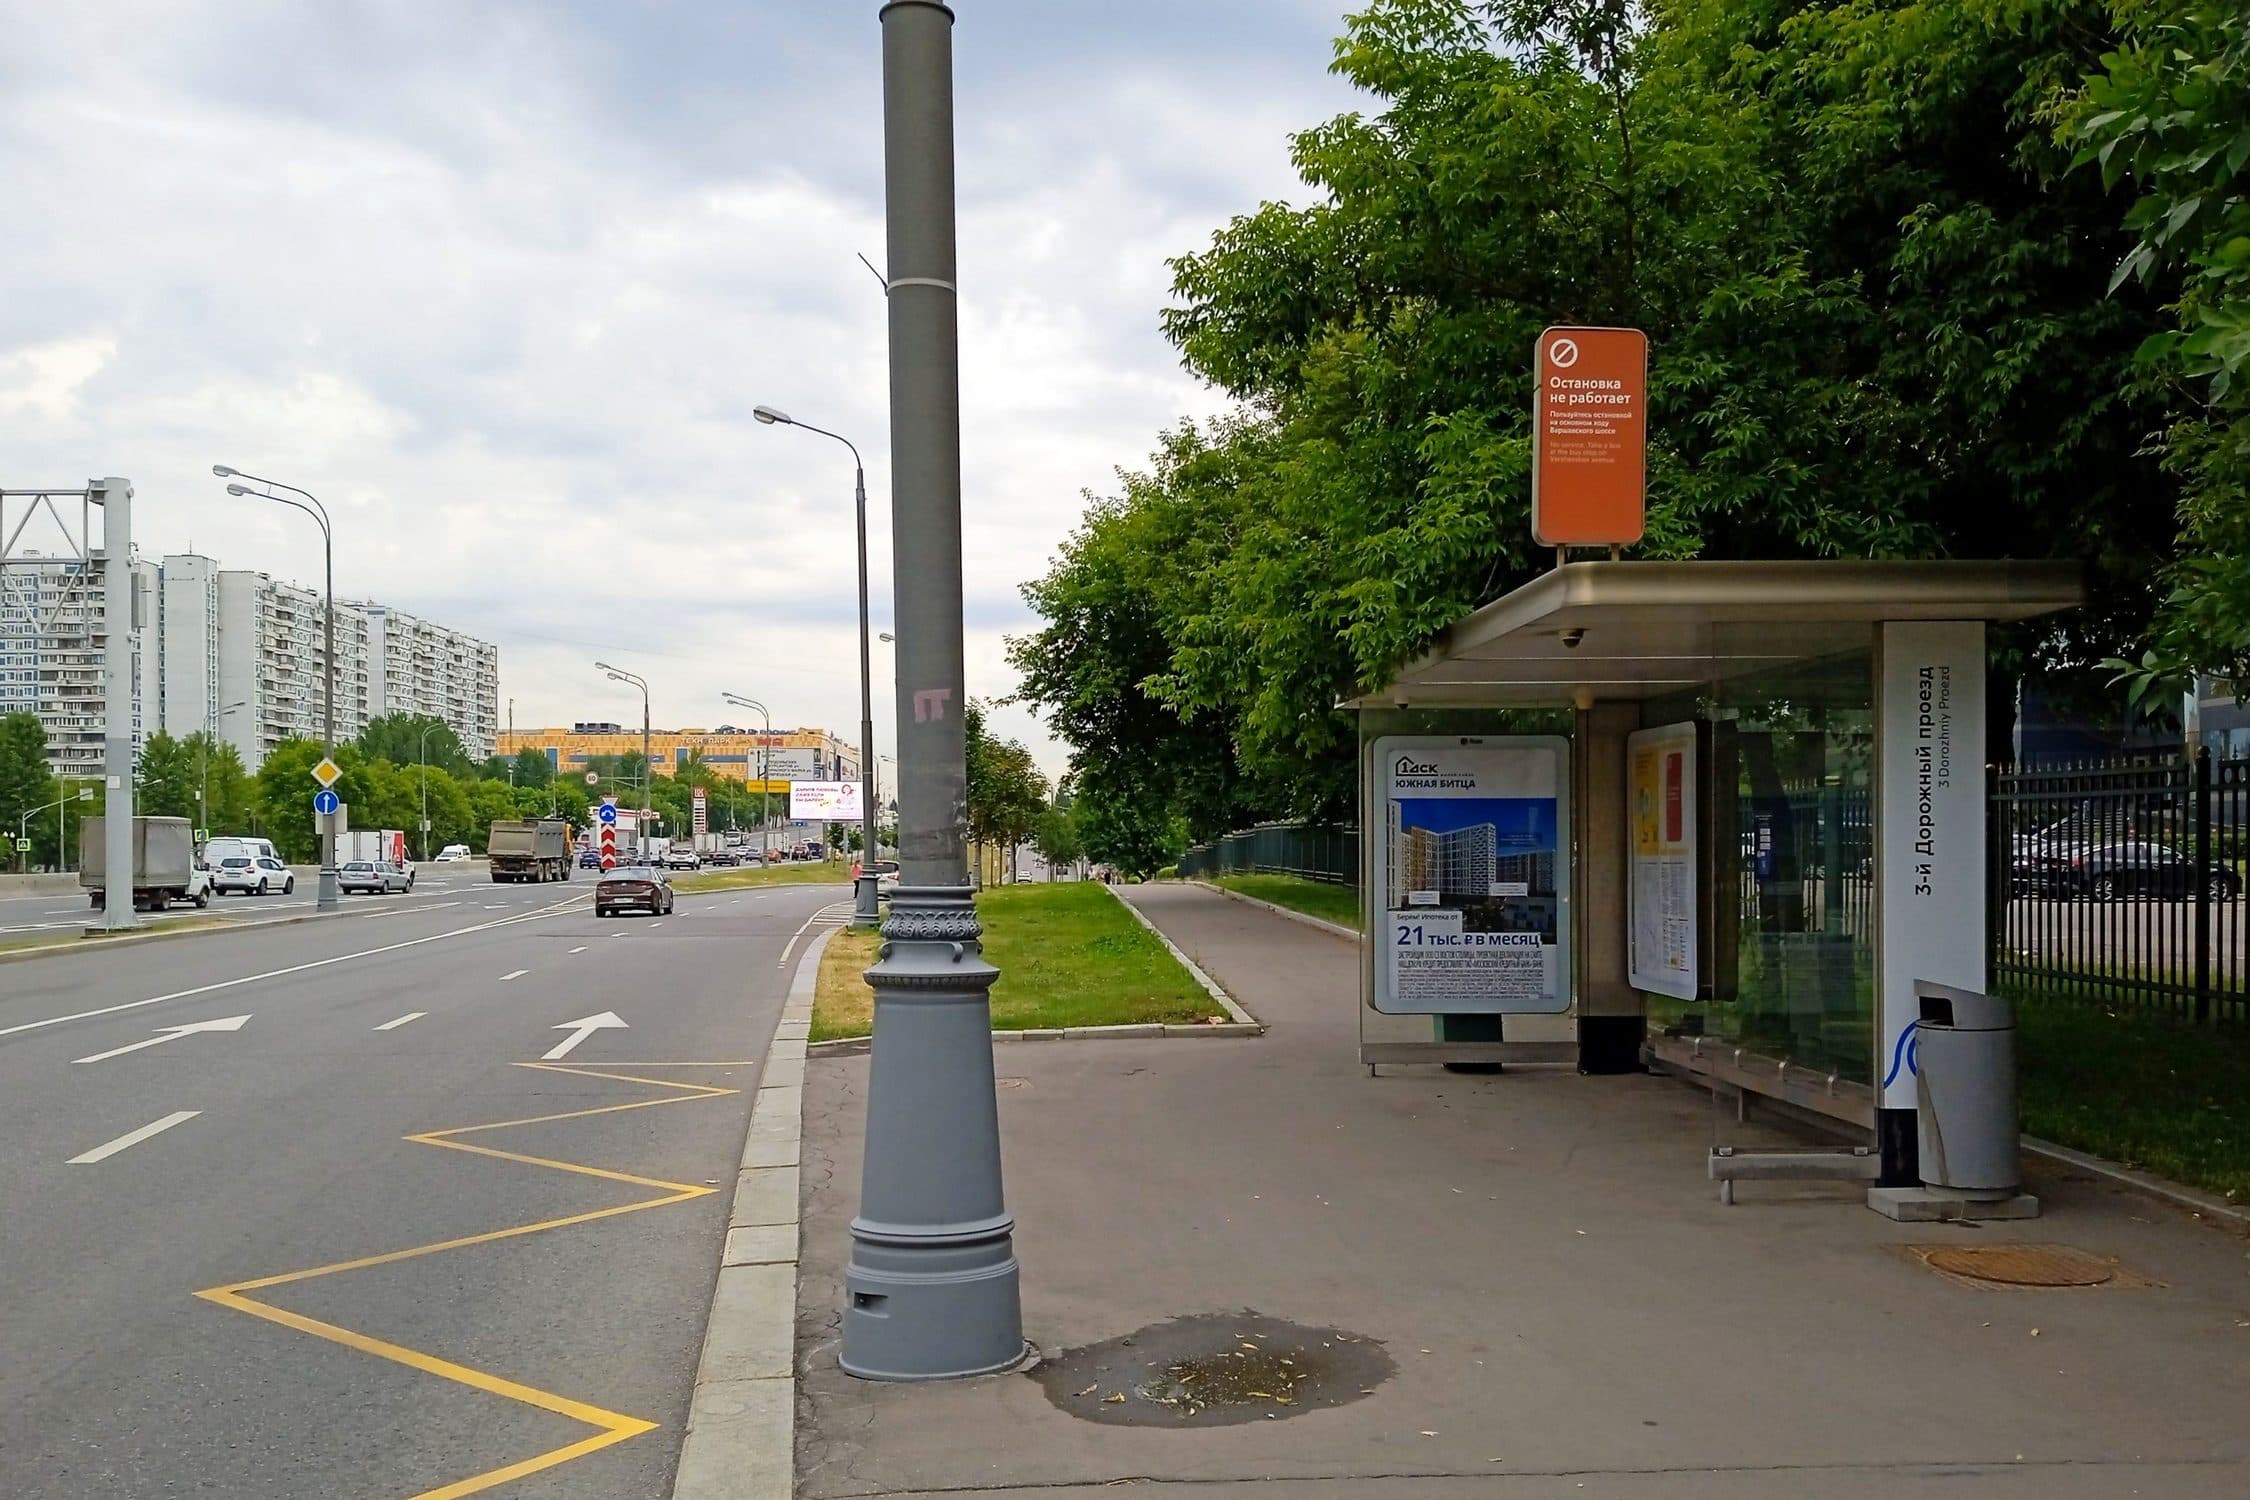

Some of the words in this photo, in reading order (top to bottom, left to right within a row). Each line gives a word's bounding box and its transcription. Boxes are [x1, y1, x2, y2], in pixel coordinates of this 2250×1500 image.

[1550, 376, 1622, 389] Остановка
[1550, 394, 1566, 403] не
[1569, 392, 1631, 406] работает
[1938, 666, 1950, 710] Proezd
[1917, 666, 1934, 739] проезд
[1938, 714, 1952, 778] Dorozhniy
[1396, 780, 1437, 788] ЮЖНАЯ
[1440, 780, 1476, 790] БИТЦА
[1938, 780, 1950, 788] 3
[1915, 746, 1935, 856] Дорожный
[1915, 864, 1932, 896] 3-й
[1397, 926, 1423, 945] 21
[1428, 935, 1462, 945] тыс.
[1476, 935, 1485, 945] в
[1489, 935, 1540, 948] месяц
